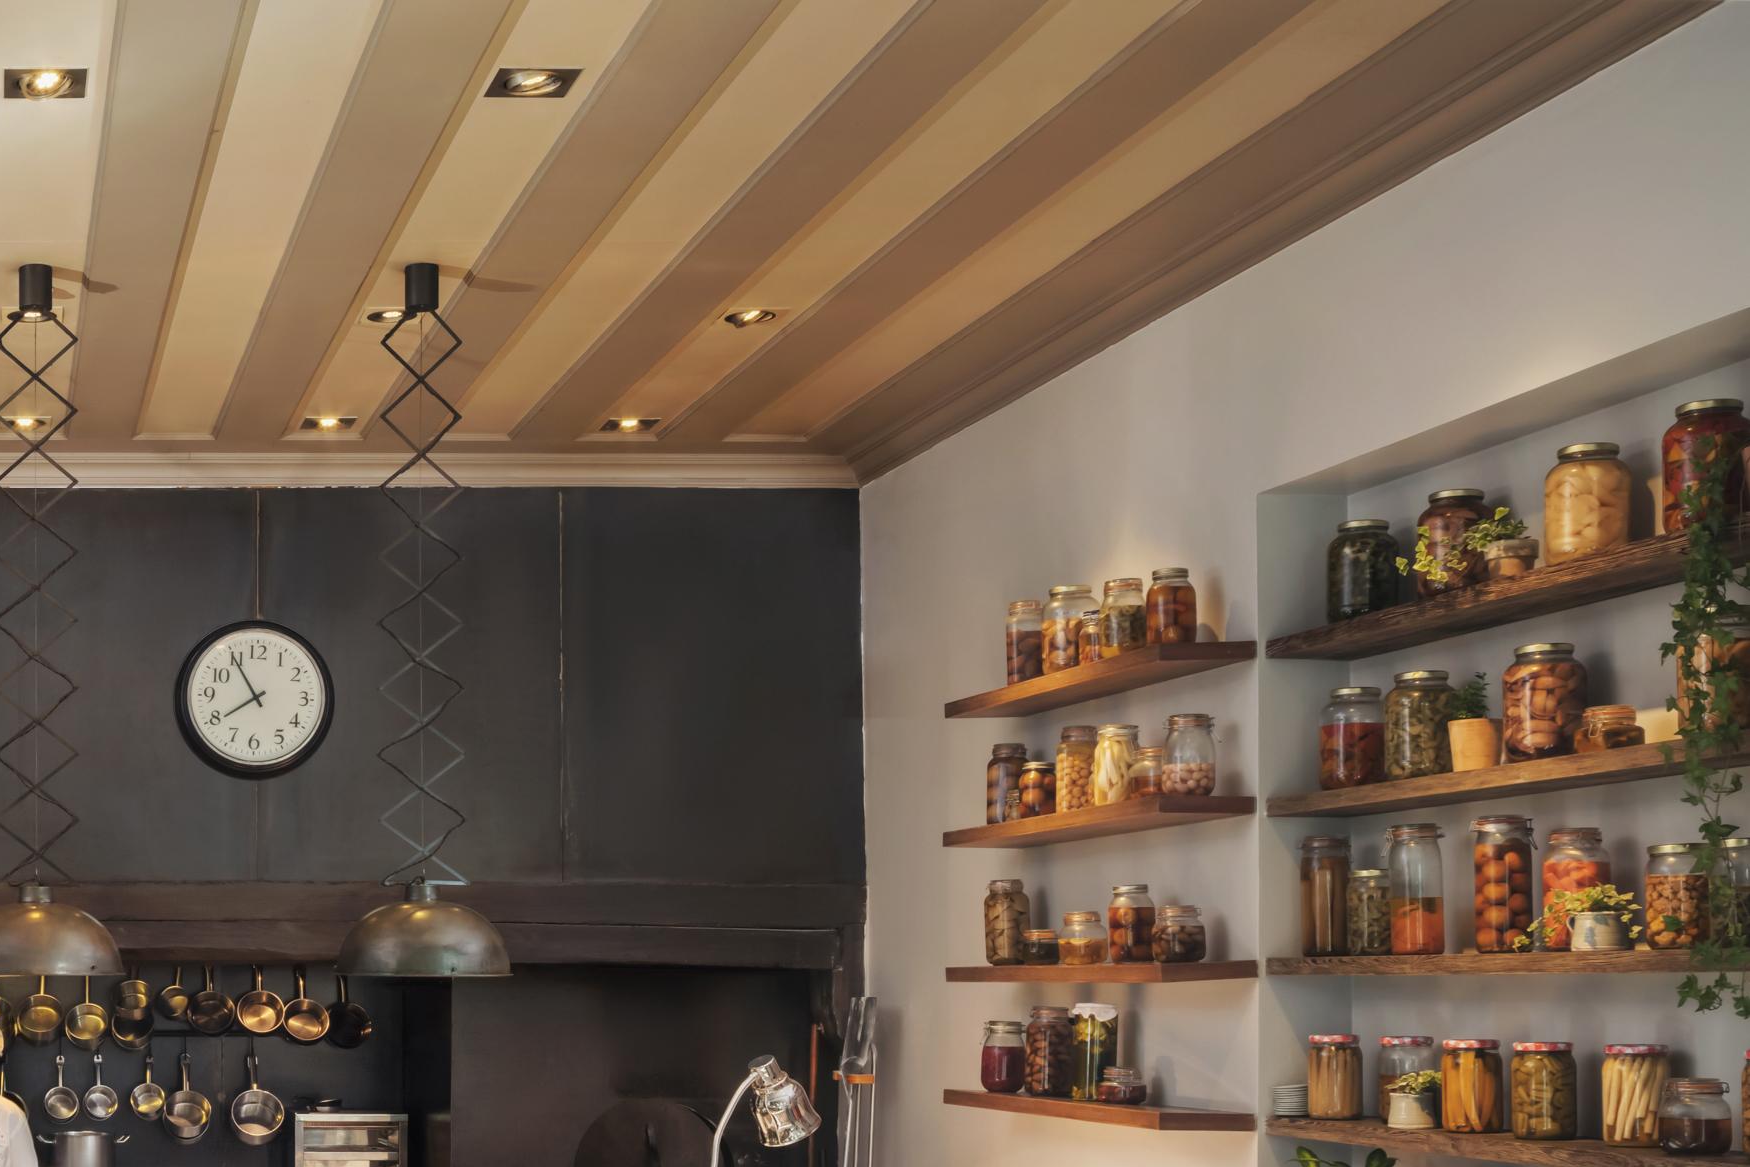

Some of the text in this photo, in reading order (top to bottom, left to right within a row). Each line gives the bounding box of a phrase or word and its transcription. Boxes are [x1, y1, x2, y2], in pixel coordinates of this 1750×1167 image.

[230, 651, 243, 666] 11
[250, 645, 267, 660] 12
[277, 652, 283, 667] 1
[213, 668, 230, 683] 10
[290, 668, 301, 682] 2
[203, 686, 215, 703] 9
[298, 691, 308, 707] 3
[210, 710, 221, 726] 8
[289, 712, 300, 728] 4
[229, 728, 239, 742] 7
[248, 733, 260, 749] 6
[274, 729, 285, 744] 5
